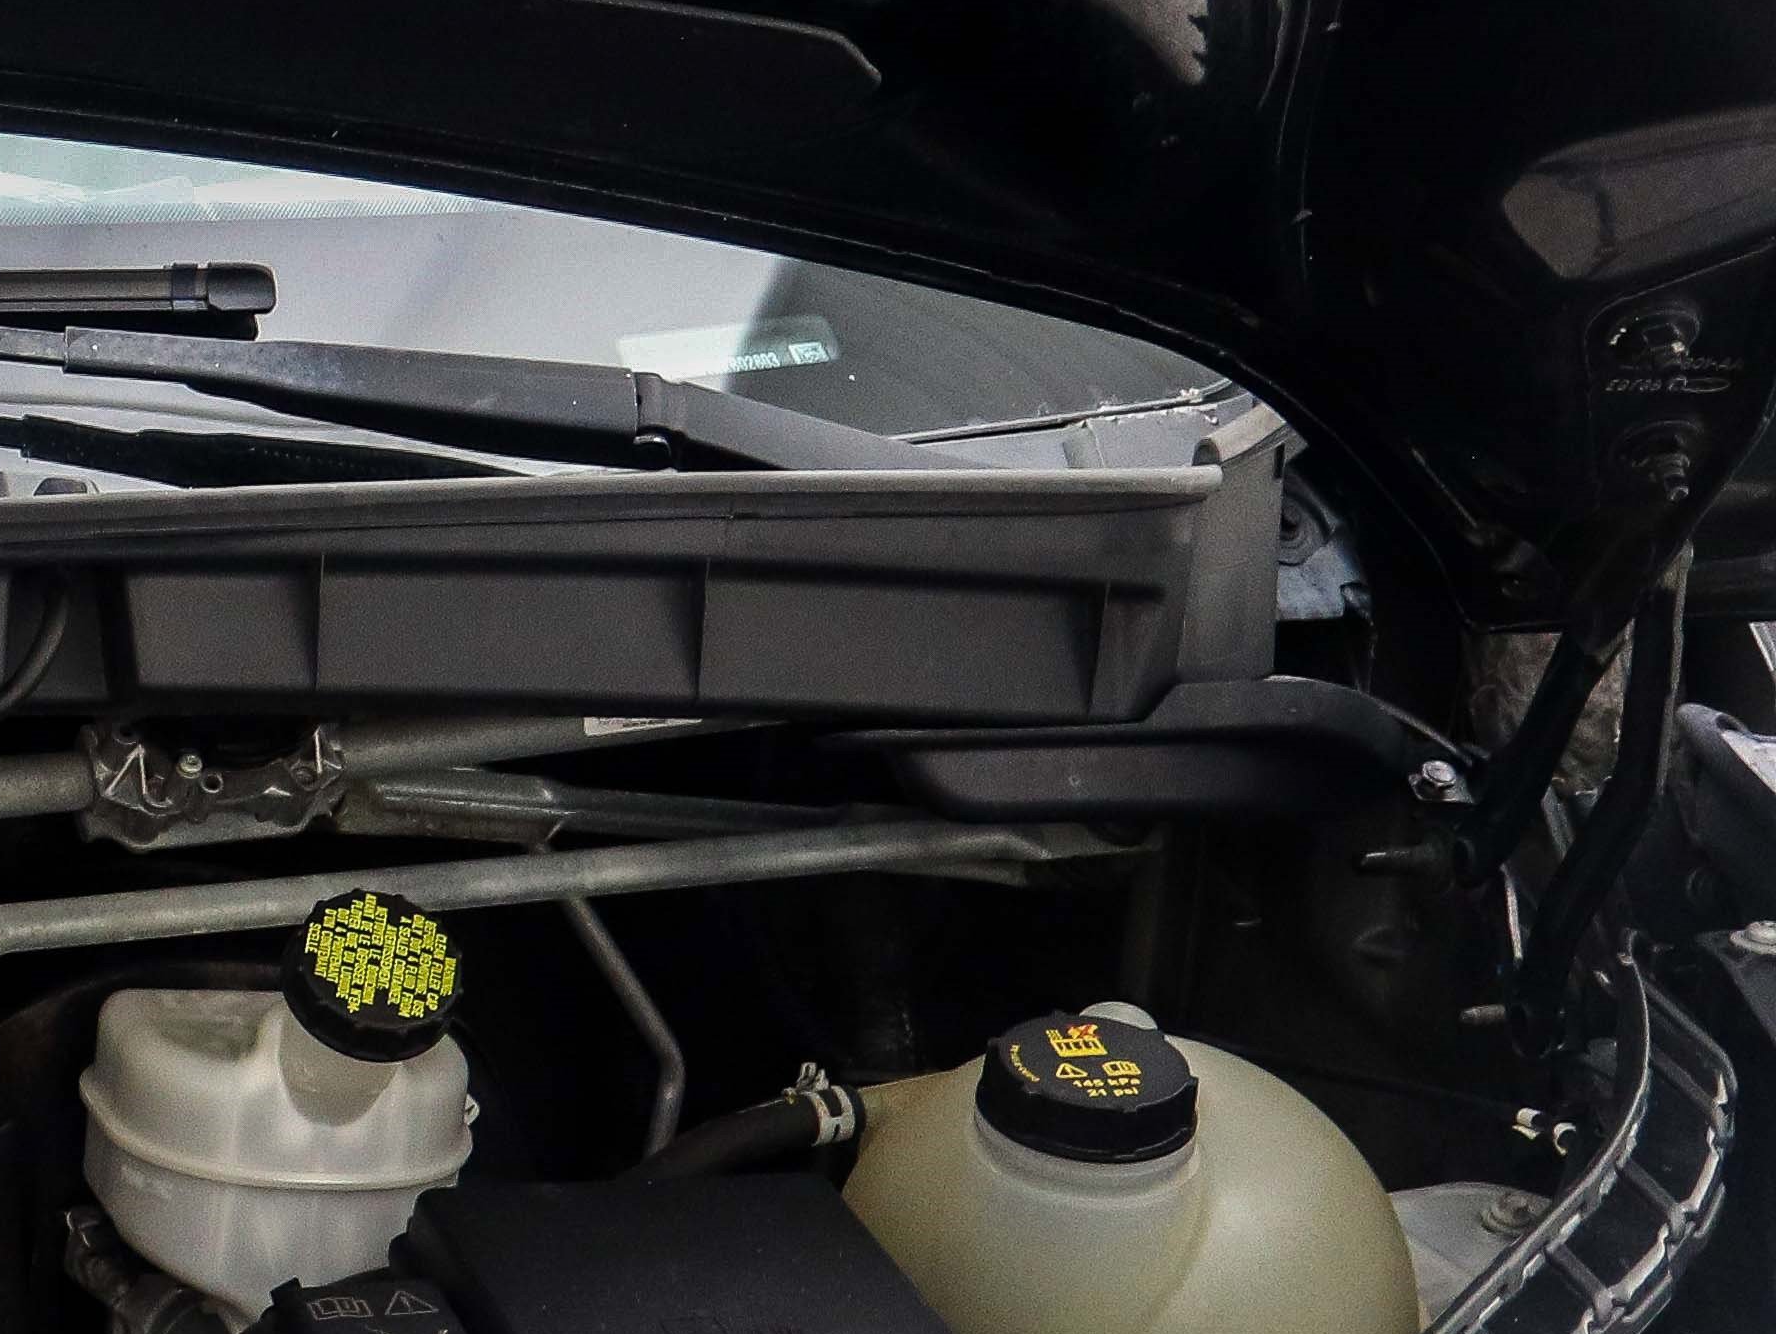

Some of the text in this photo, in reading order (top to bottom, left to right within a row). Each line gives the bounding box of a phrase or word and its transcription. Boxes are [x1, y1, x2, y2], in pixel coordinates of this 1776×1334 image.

[337, 908, 349, 923] DOT
[349, 900, 364, 929] PLOYER
[363, 893, 377, 918] AVANT
[361, 921, 373, 933] DE
[372, 906, 388, 946] NETTOYER
[412, 914, 424, 934] ONLY
[422, 921, 437, 951] BEFORE
[346, 932, 358, 948] QUE
[359, 935, 370, 946] LE
[396, 926, 410, 956] SEALED
[409, 937, 421, 953] DOT
[315, 931, 333, 978] CONTENANT
[326, 936, 345, 984] PROVENANT
[344, 951, 355, 963] DU
[369, 949, 381, 958] LE
[404, 965, 417, 989] FLUID
[426, 934, 446, 1011] CLEAN FILLER CAP
[398, 992, 413, 1018] FROM
[411, 999, 425, 1018] USE
